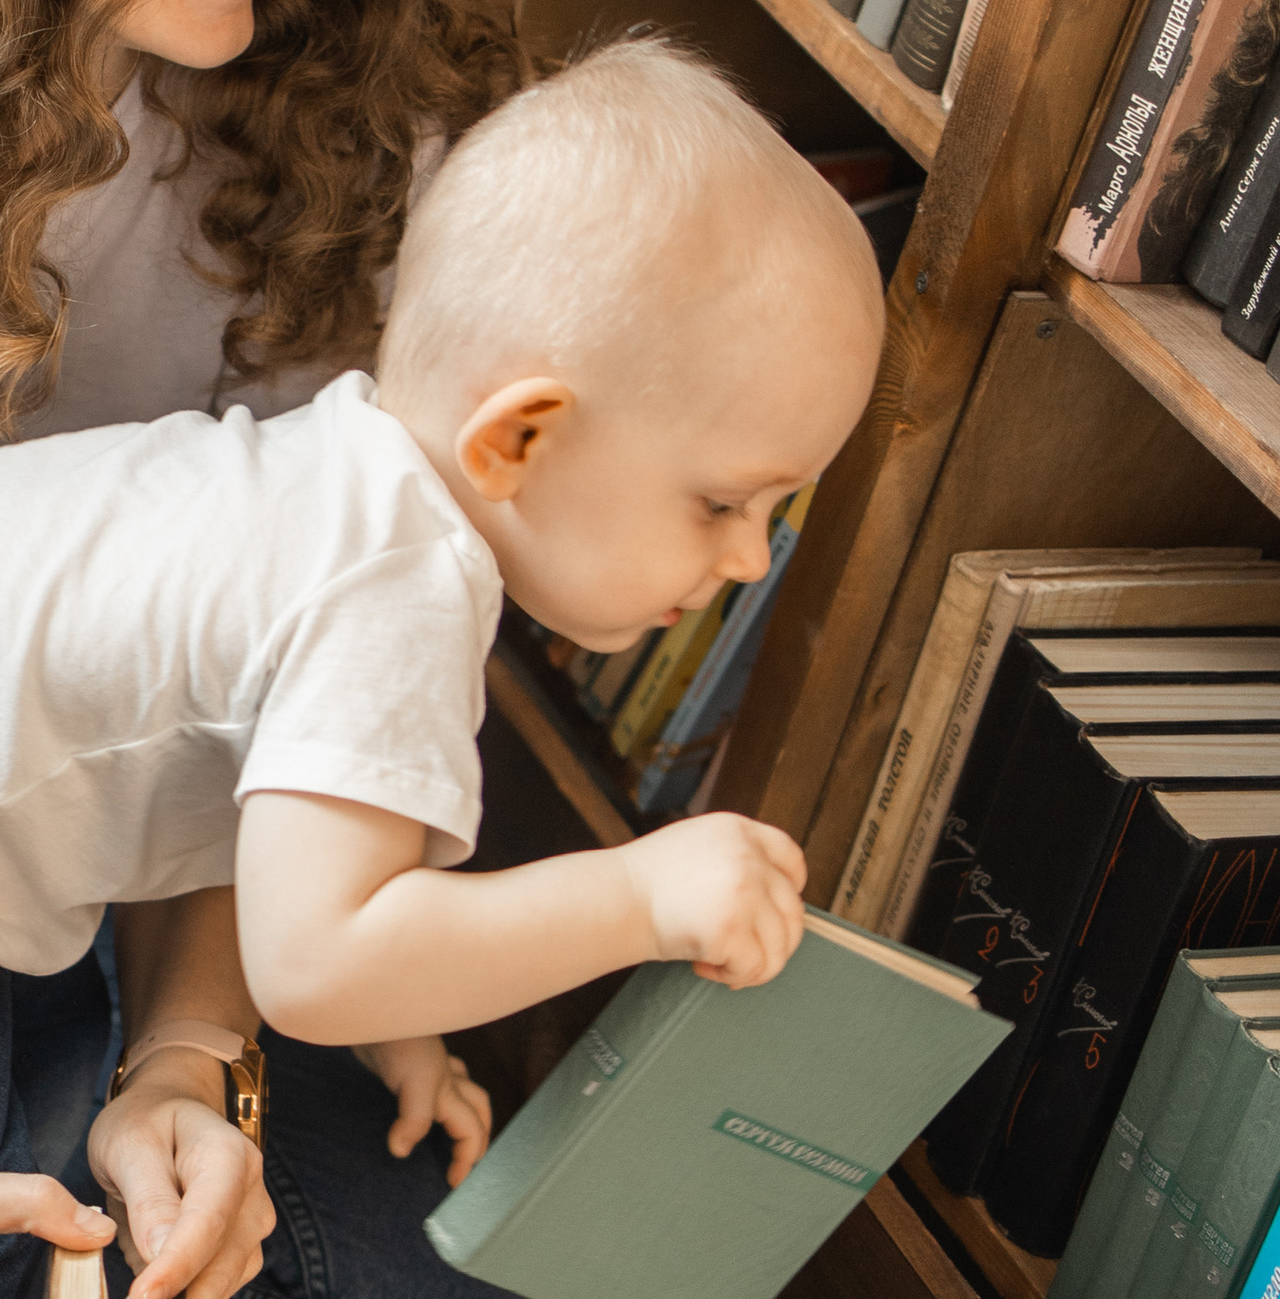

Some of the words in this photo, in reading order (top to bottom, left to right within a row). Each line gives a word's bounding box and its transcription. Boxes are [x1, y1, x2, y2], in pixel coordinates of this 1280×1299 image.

[1237, 154, 1260, 195] Серж
[1255, 115, 1280, 157] Голон
[1097, 164, 1128, 215] Марго
[1240, 243, 1279, 321] Зарубежный
[878, 726, 914, 814] ТОЛСТОЙ
[978, 925, 1000, 962] 2
[1023, 964, 1044, 1005] 3
[1084, 1032, 1108, 1070] 5
[1119, 1151, 1135, 1172] 2
